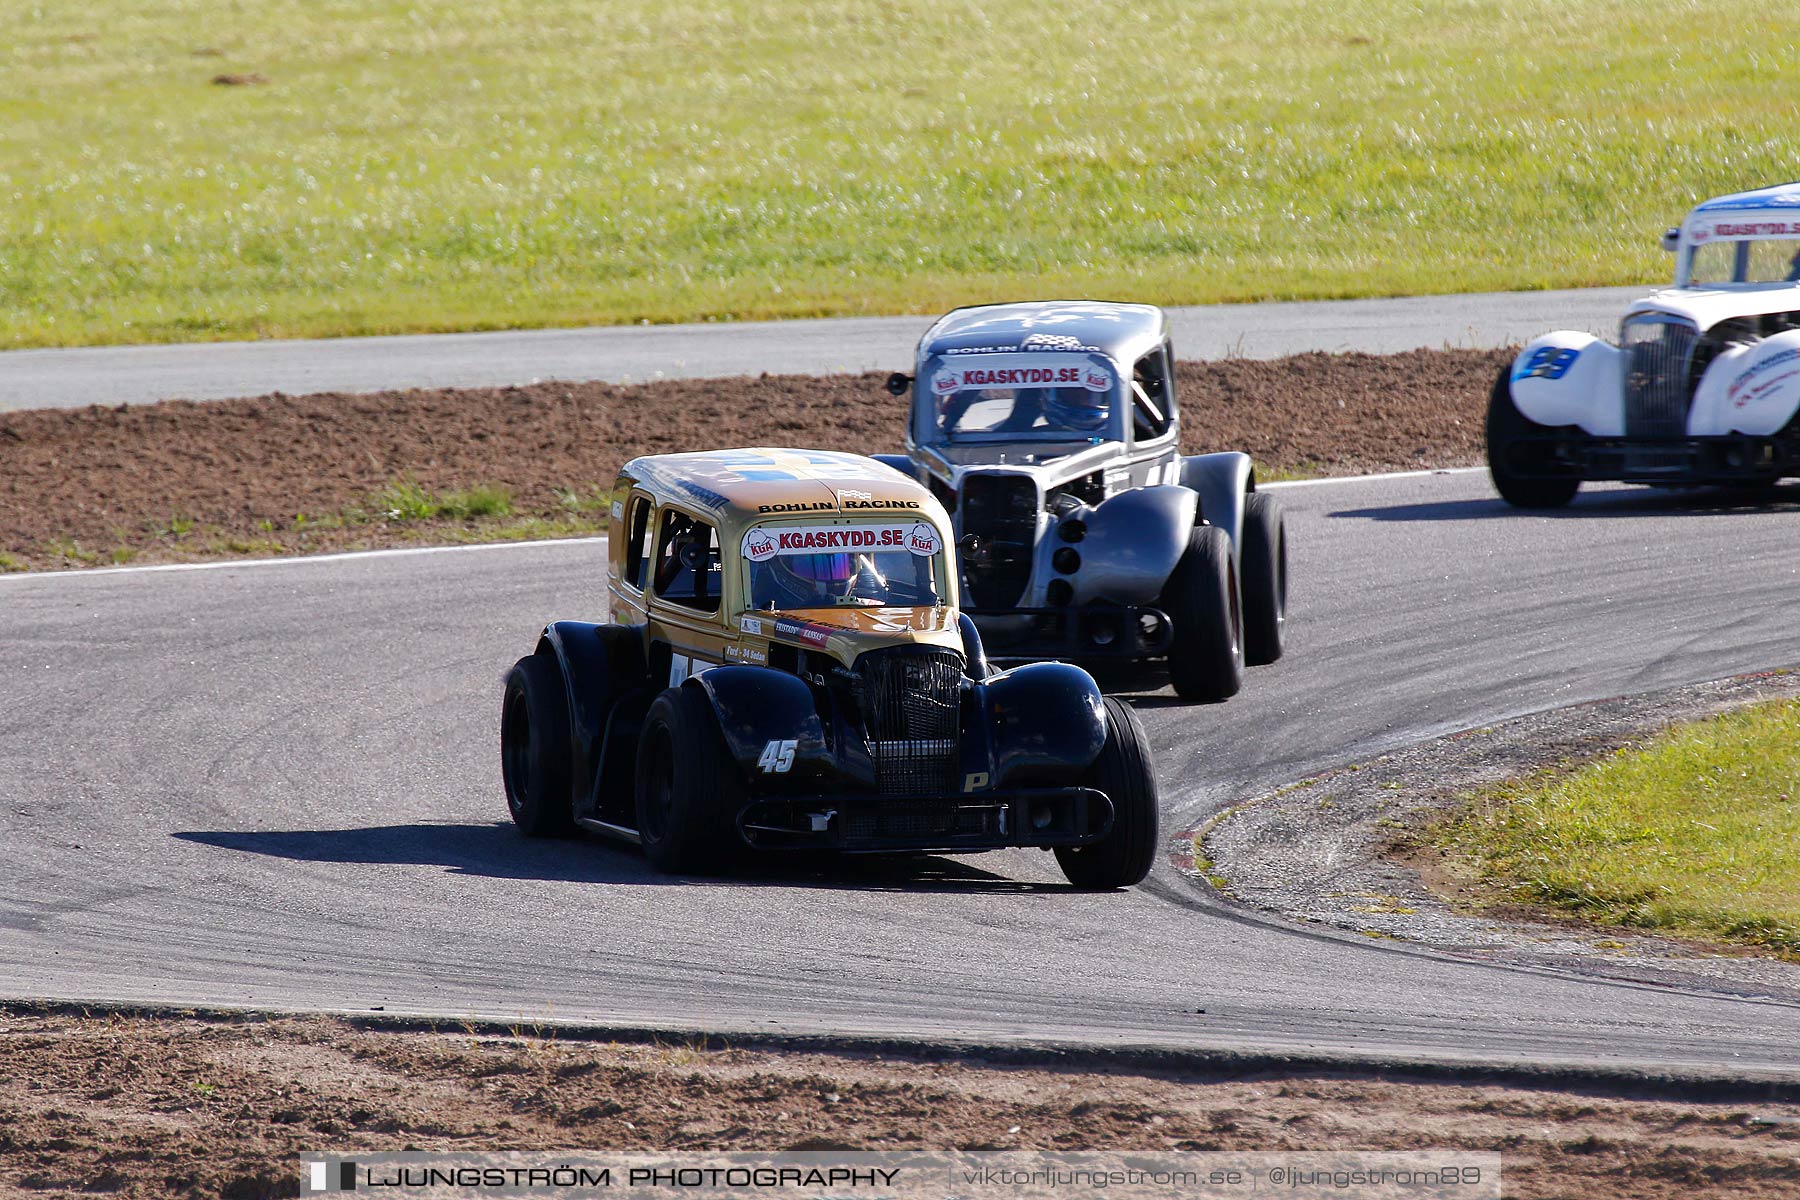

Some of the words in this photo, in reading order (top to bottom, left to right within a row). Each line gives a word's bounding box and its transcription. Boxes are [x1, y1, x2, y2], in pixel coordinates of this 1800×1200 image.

[946, 345, 1017, 354] BOHLIN
[1028, 344, 1100, 352] RACING
[963, 368, 1080, 385] KGASKYDD.SE
[758, 502, 833, 514] BOHLIN
[845, 500, 920, 509] RACING
[779, 530, 904, 549] KGASKYDD.SE
[911, 537, 932, 550] KGA
[751, 541, 773, 555] KGA
[727, 645, 739, 656] Ford
[757, 739, 799, 774] 45
